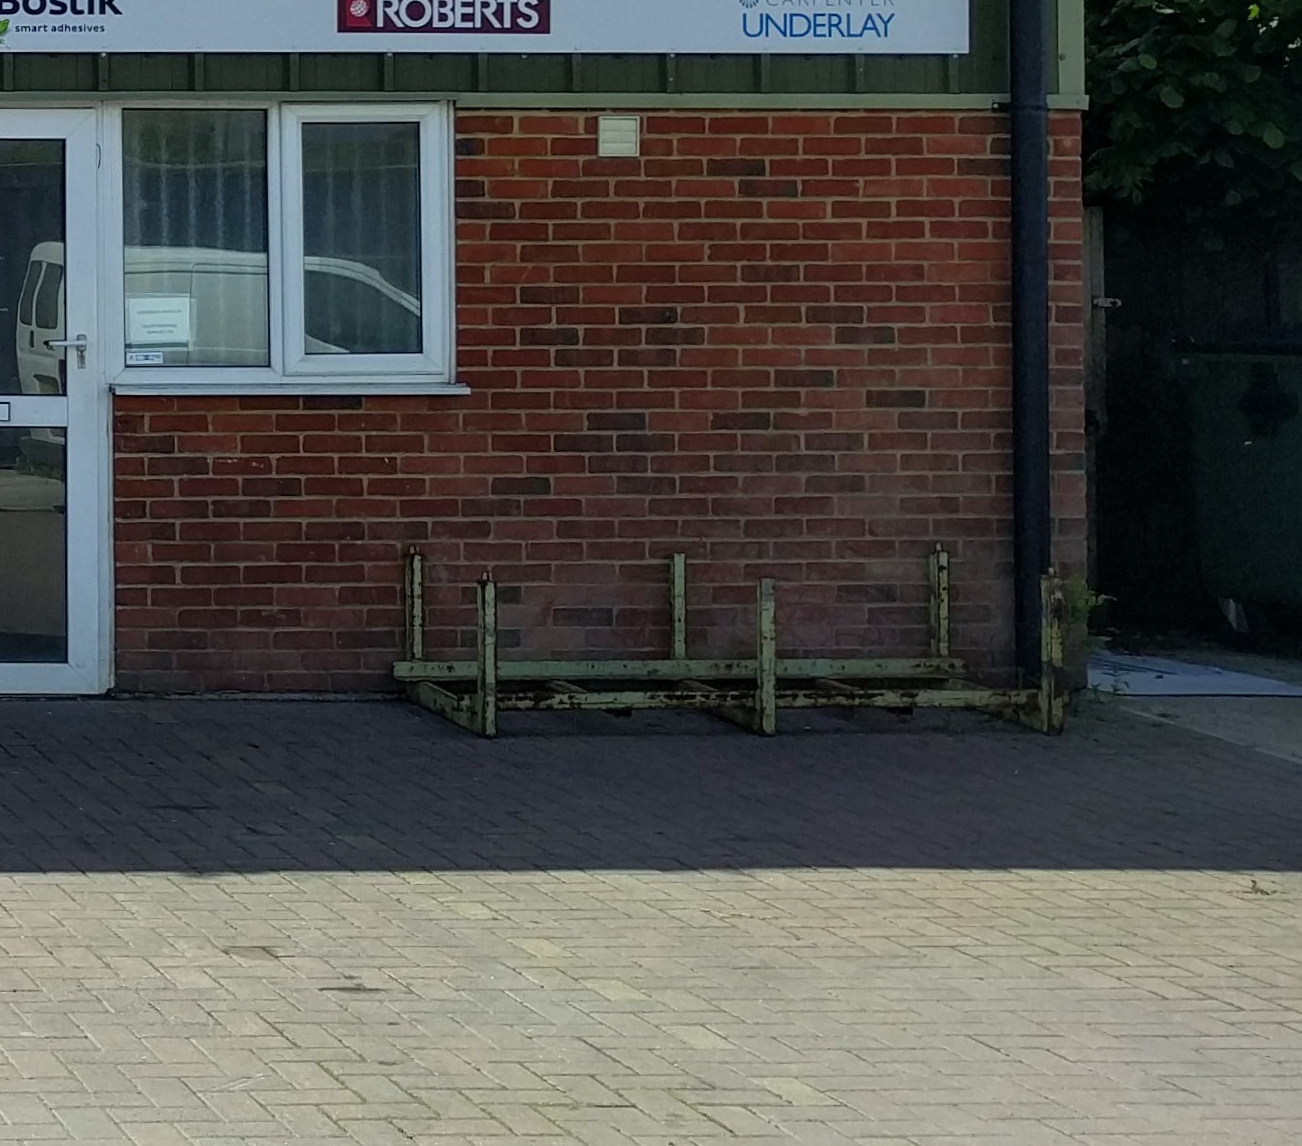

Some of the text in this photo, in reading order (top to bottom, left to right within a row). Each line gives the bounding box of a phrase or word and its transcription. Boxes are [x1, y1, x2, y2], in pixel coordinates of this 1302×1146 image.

[15, 23, 105, 33] smart adhesives
[742, 13, 895, 38] UNDERLAY
